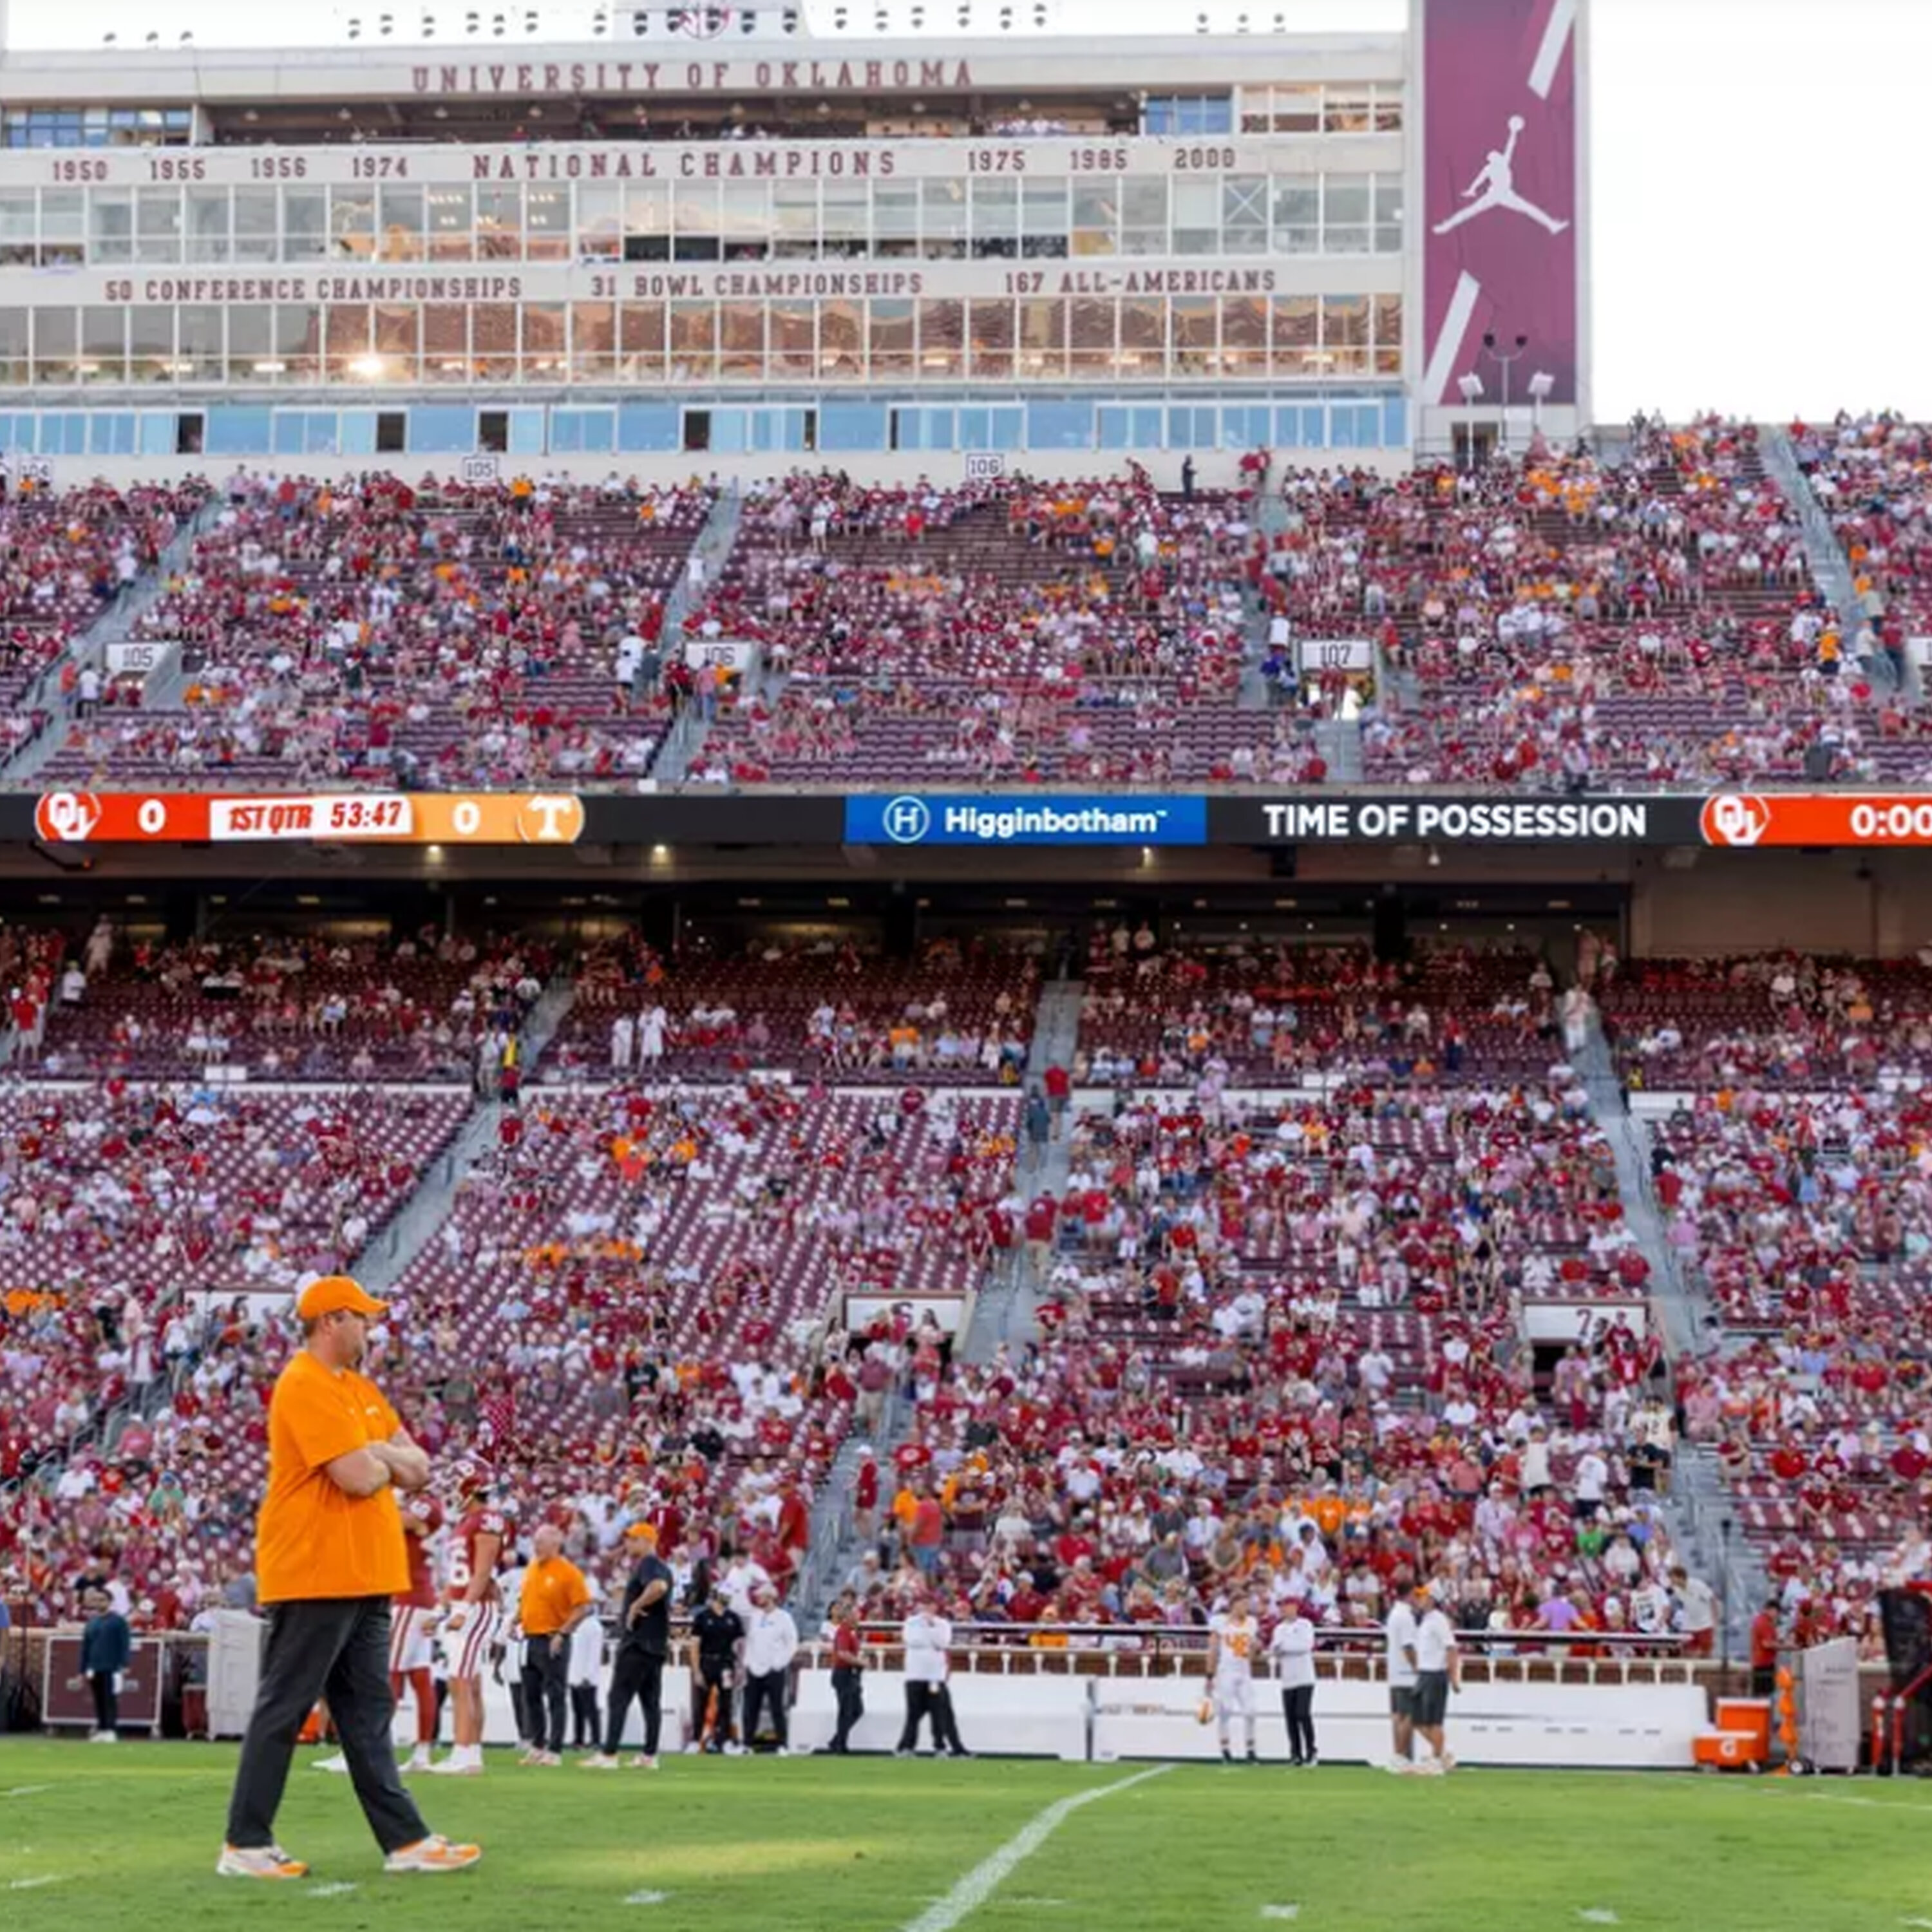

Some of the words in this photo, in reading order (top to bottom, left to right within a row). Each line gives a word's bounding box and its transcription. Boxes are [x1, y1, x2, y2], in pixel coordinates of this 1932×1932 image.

[412, 62, 661, 91] UNIVERSITY
[687, 61, 730, 90] OF
[756, 59, 973, 88] OKLAHOMA
[149, 158, 206, 181] 1955
[251, 156, 307, 179] 1956
[352, 155, 408, 178] 1974
[473, 152, 657, 180] NATIONAL
[680, 149, 895, 178] CHAMPIONS
[967, 148, 1026, 172] 1975
[1070, 147, 1128, 171] 1985
[1173, 146, 1236, 170] 2000
[52, 159, 109, 182] 1950
[105, 279, 133, 302] 50
[145, 278, 306, 301] CONFERENCE
[317, 276, 522, 300] CHAMPIONSHIPS
[591, 274, 617, 298] 31
[634, 274, 704, 298] BOWL
[714, 272, 923, 296] CHAMPIONSHIPS
[1005, 270, 1045, 294] 167
[1059, 269, 1276, 294] ALL-AMERICANS
[971, 458, 999, 475] 106
[123, 646, 154, 668] 105
[1321, 643, 1352, 666] 107
[138, 799, 166, 835] 0
[229, 806, 265, 831] 1ST
[268, 804, 314, 835] QTR
[330, 800, 402, 829] 53:47
[452, 800, 481, 835] 0
[1263, 804, 1349, 836] TIME
[1358, 804, 1408, 837] OF
[1417, 804, 1646, 837] POSSESSION
[1576, 1307, 1592, 1336] 7
